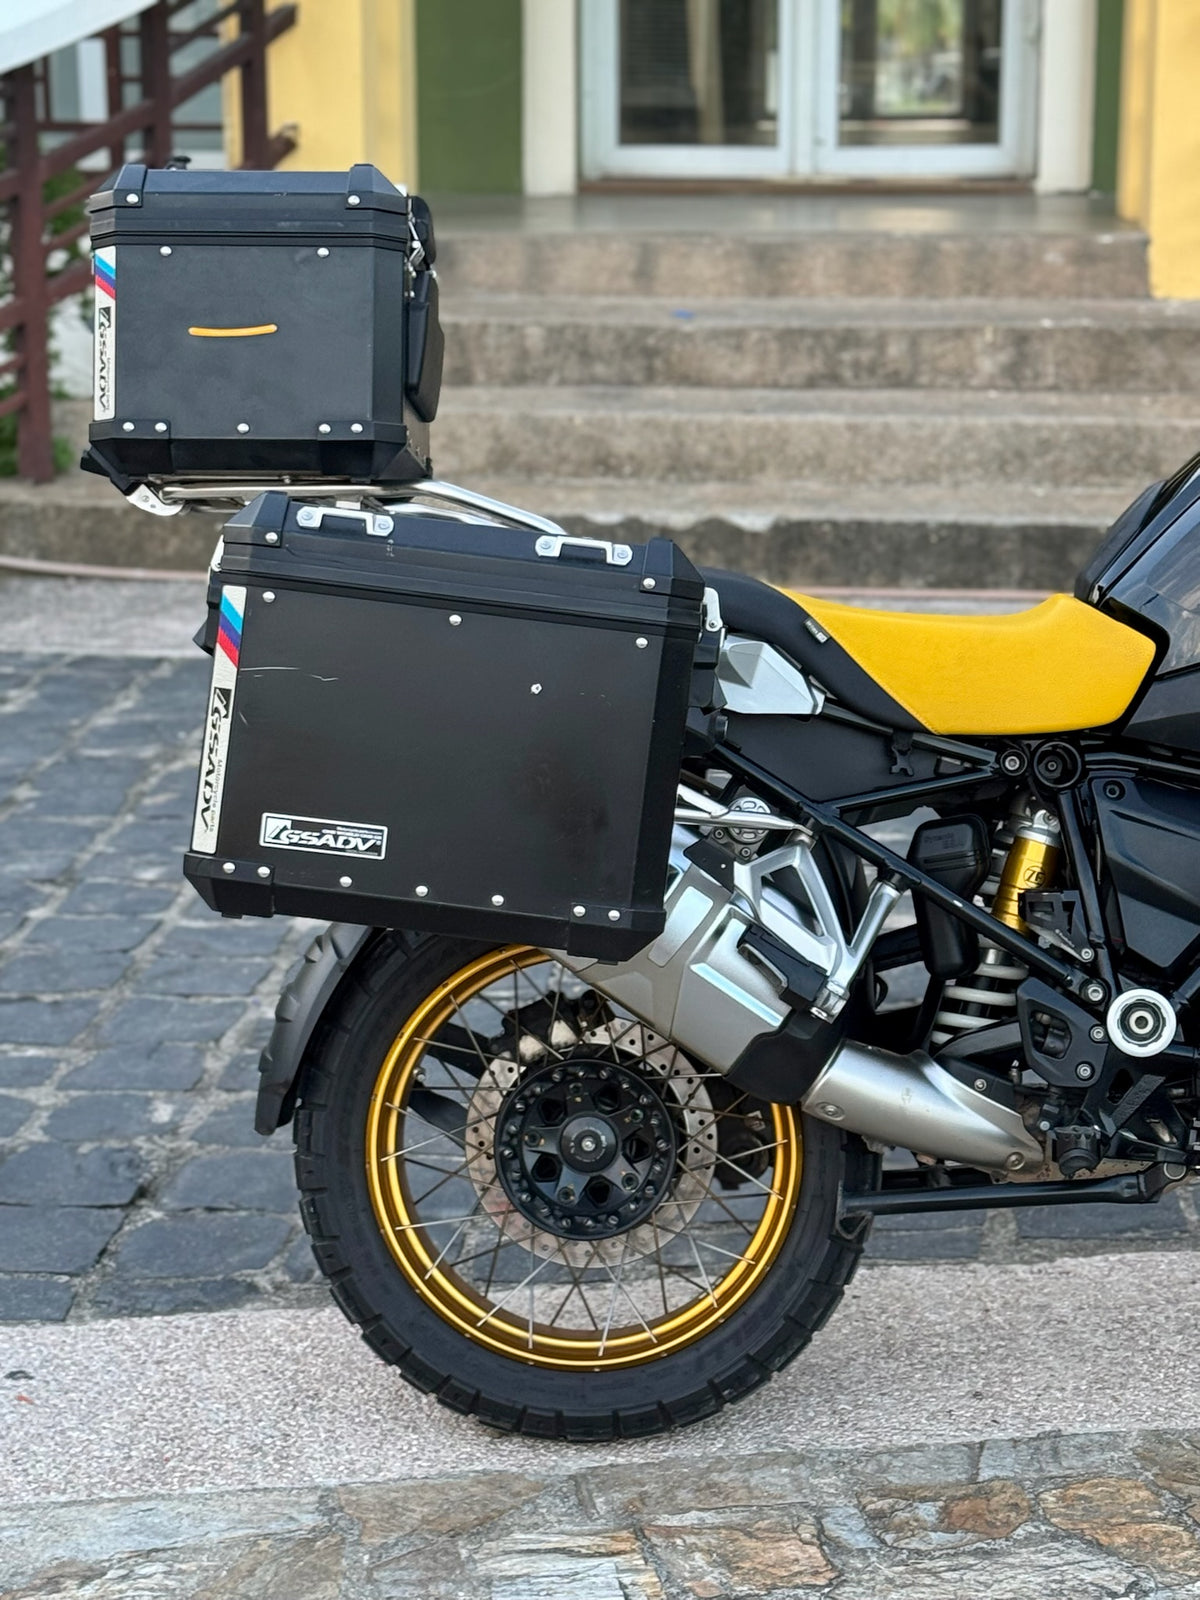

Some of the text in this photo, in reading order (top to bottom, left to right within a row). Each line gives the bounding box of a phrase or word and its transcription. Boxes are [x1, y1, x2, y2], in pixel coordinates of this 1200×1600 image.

[201, 707, 222, 830] GSADV
[280, 829, 376, 851] GSADV
[1025, 868, 1046, 885] ZF
